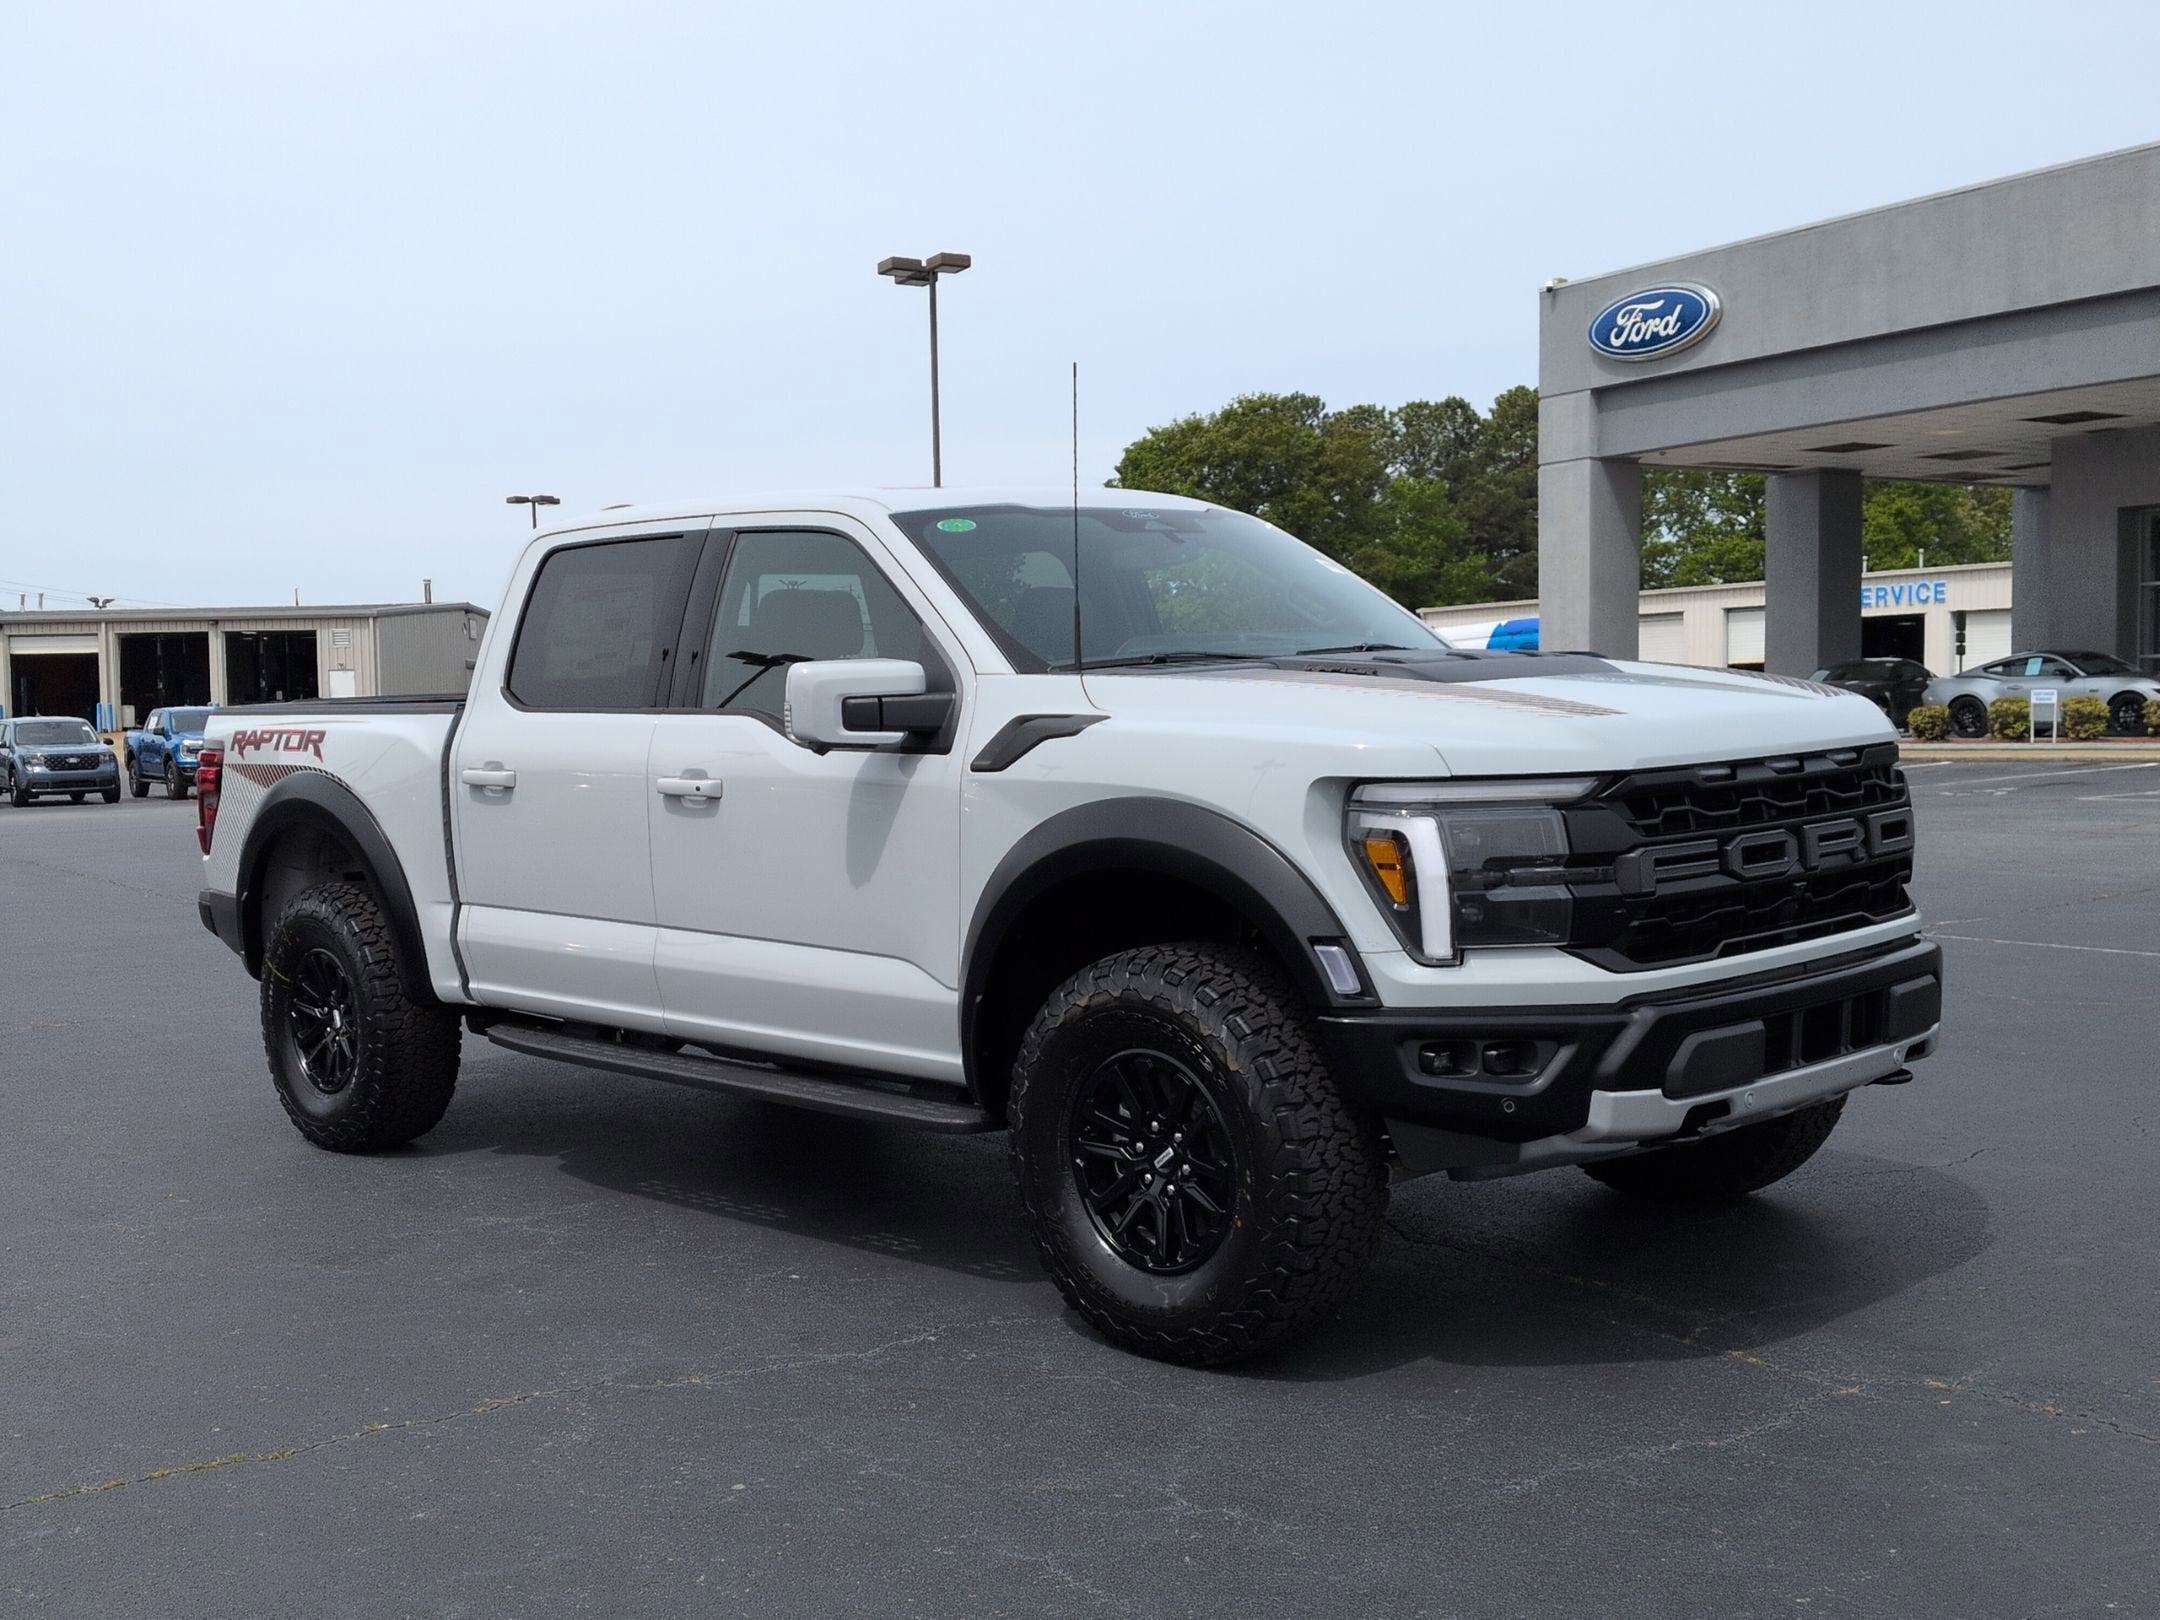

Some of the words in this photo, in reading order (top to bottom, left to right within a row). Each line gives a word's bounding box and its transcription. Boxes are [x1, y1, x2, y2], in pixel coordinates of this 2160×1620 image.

[1610, 299, 1683, 347] Ford
[1860, 581, 1947, 608] ERVICE
[230, 730, 326, 763] RAPTOR
[1617, 807, 1915, 898] FORD
